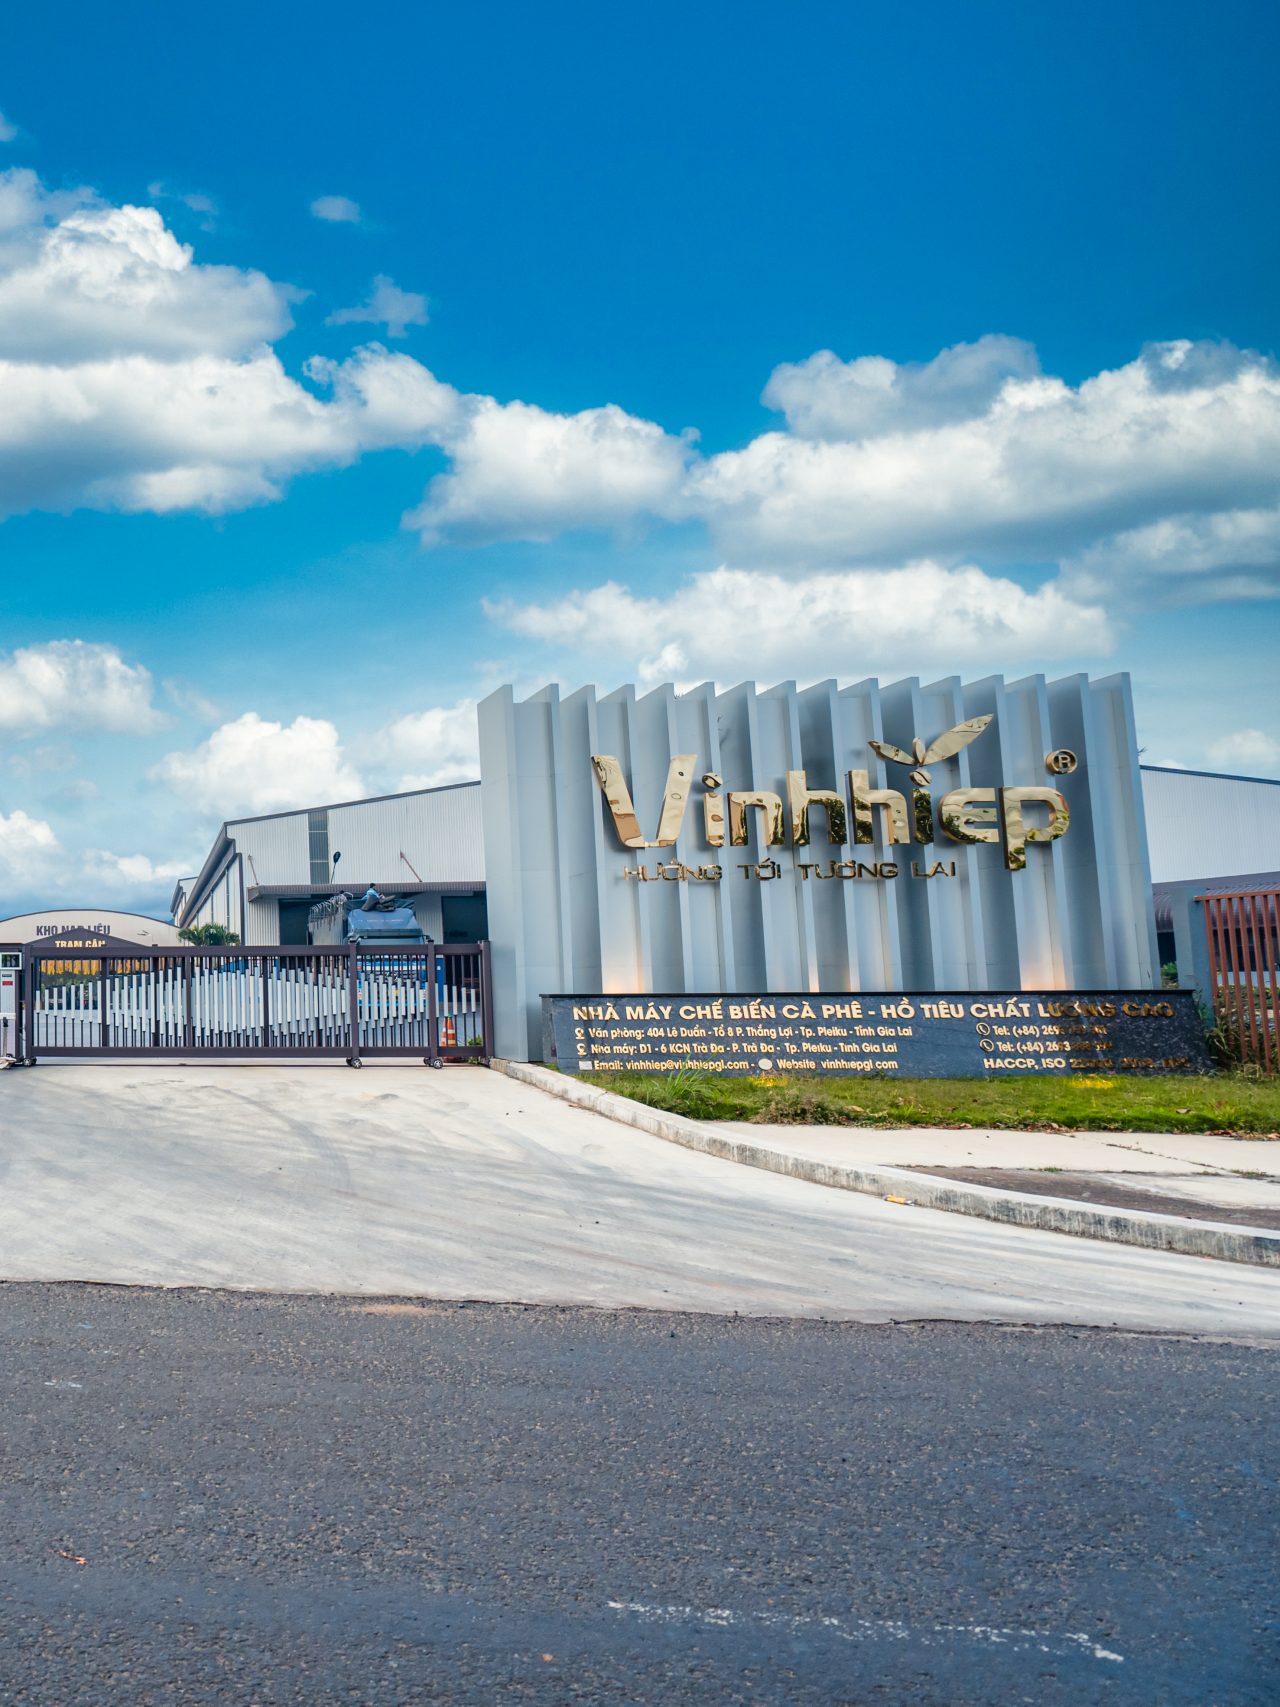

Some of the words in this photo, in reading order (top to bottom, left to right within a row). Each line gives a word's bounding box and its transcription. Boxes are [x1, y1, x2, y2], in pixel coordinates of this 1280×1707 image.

[910, 861, 956, 879] LAI
[573, 1002, 620, 1021] NHÀ
[625, 1002, 672, 1020] MÁY
[679, 999, 724, 1020] CHẾ
[729, 998, 776, 1019] BIẾN
[782, 1001, 817, 1019] CÀ
[822, 1001, 863, 1019] PHÊ
[880, 997, 915, 1019] HỒ
[920, 1000, 965, 1018] TIÊU
[970, 997, 1031, 1018] CHẤT
[611, 1027, 645, 1040] phòng:
[647, 1027, 665, 1037] 404
[667, 1027, 678, 1037] Lê
[727, 1027, 734, 1037] 8
[736, 1026, 745, 1037] P.
[800, 1027, 816, 1038] Tp.
[877, 1027, 896, 1037] Gia
[897, 1026, 913, 1037] Lai
[992, 1025, 1011, 1036] Tel:
[1012, 1025, 1040, 1038] (+84)
[613, 1043, 638, 1056] máy:
[660, 1043, 667, 1053] 6
[669, 1043, 691, 1053] KCN
[692, 1043, 708, 1053] Trà
[732, 1043, 741, 1053] P.
[742, 1043, 758, 1053] Trà
[785, 1043, 800, 1054] Tp.
[862, 1043, 880, 1053] Gia
[882, 1043, 898, 1053] Lai
[996, 1042, 1014, 1052] Tel:
[1016, 1042, 1044, 1054] (+84)
[984, 1058, 1038, 1070] HACCP,
[1041, 1058, 1066, 1069] ISO
